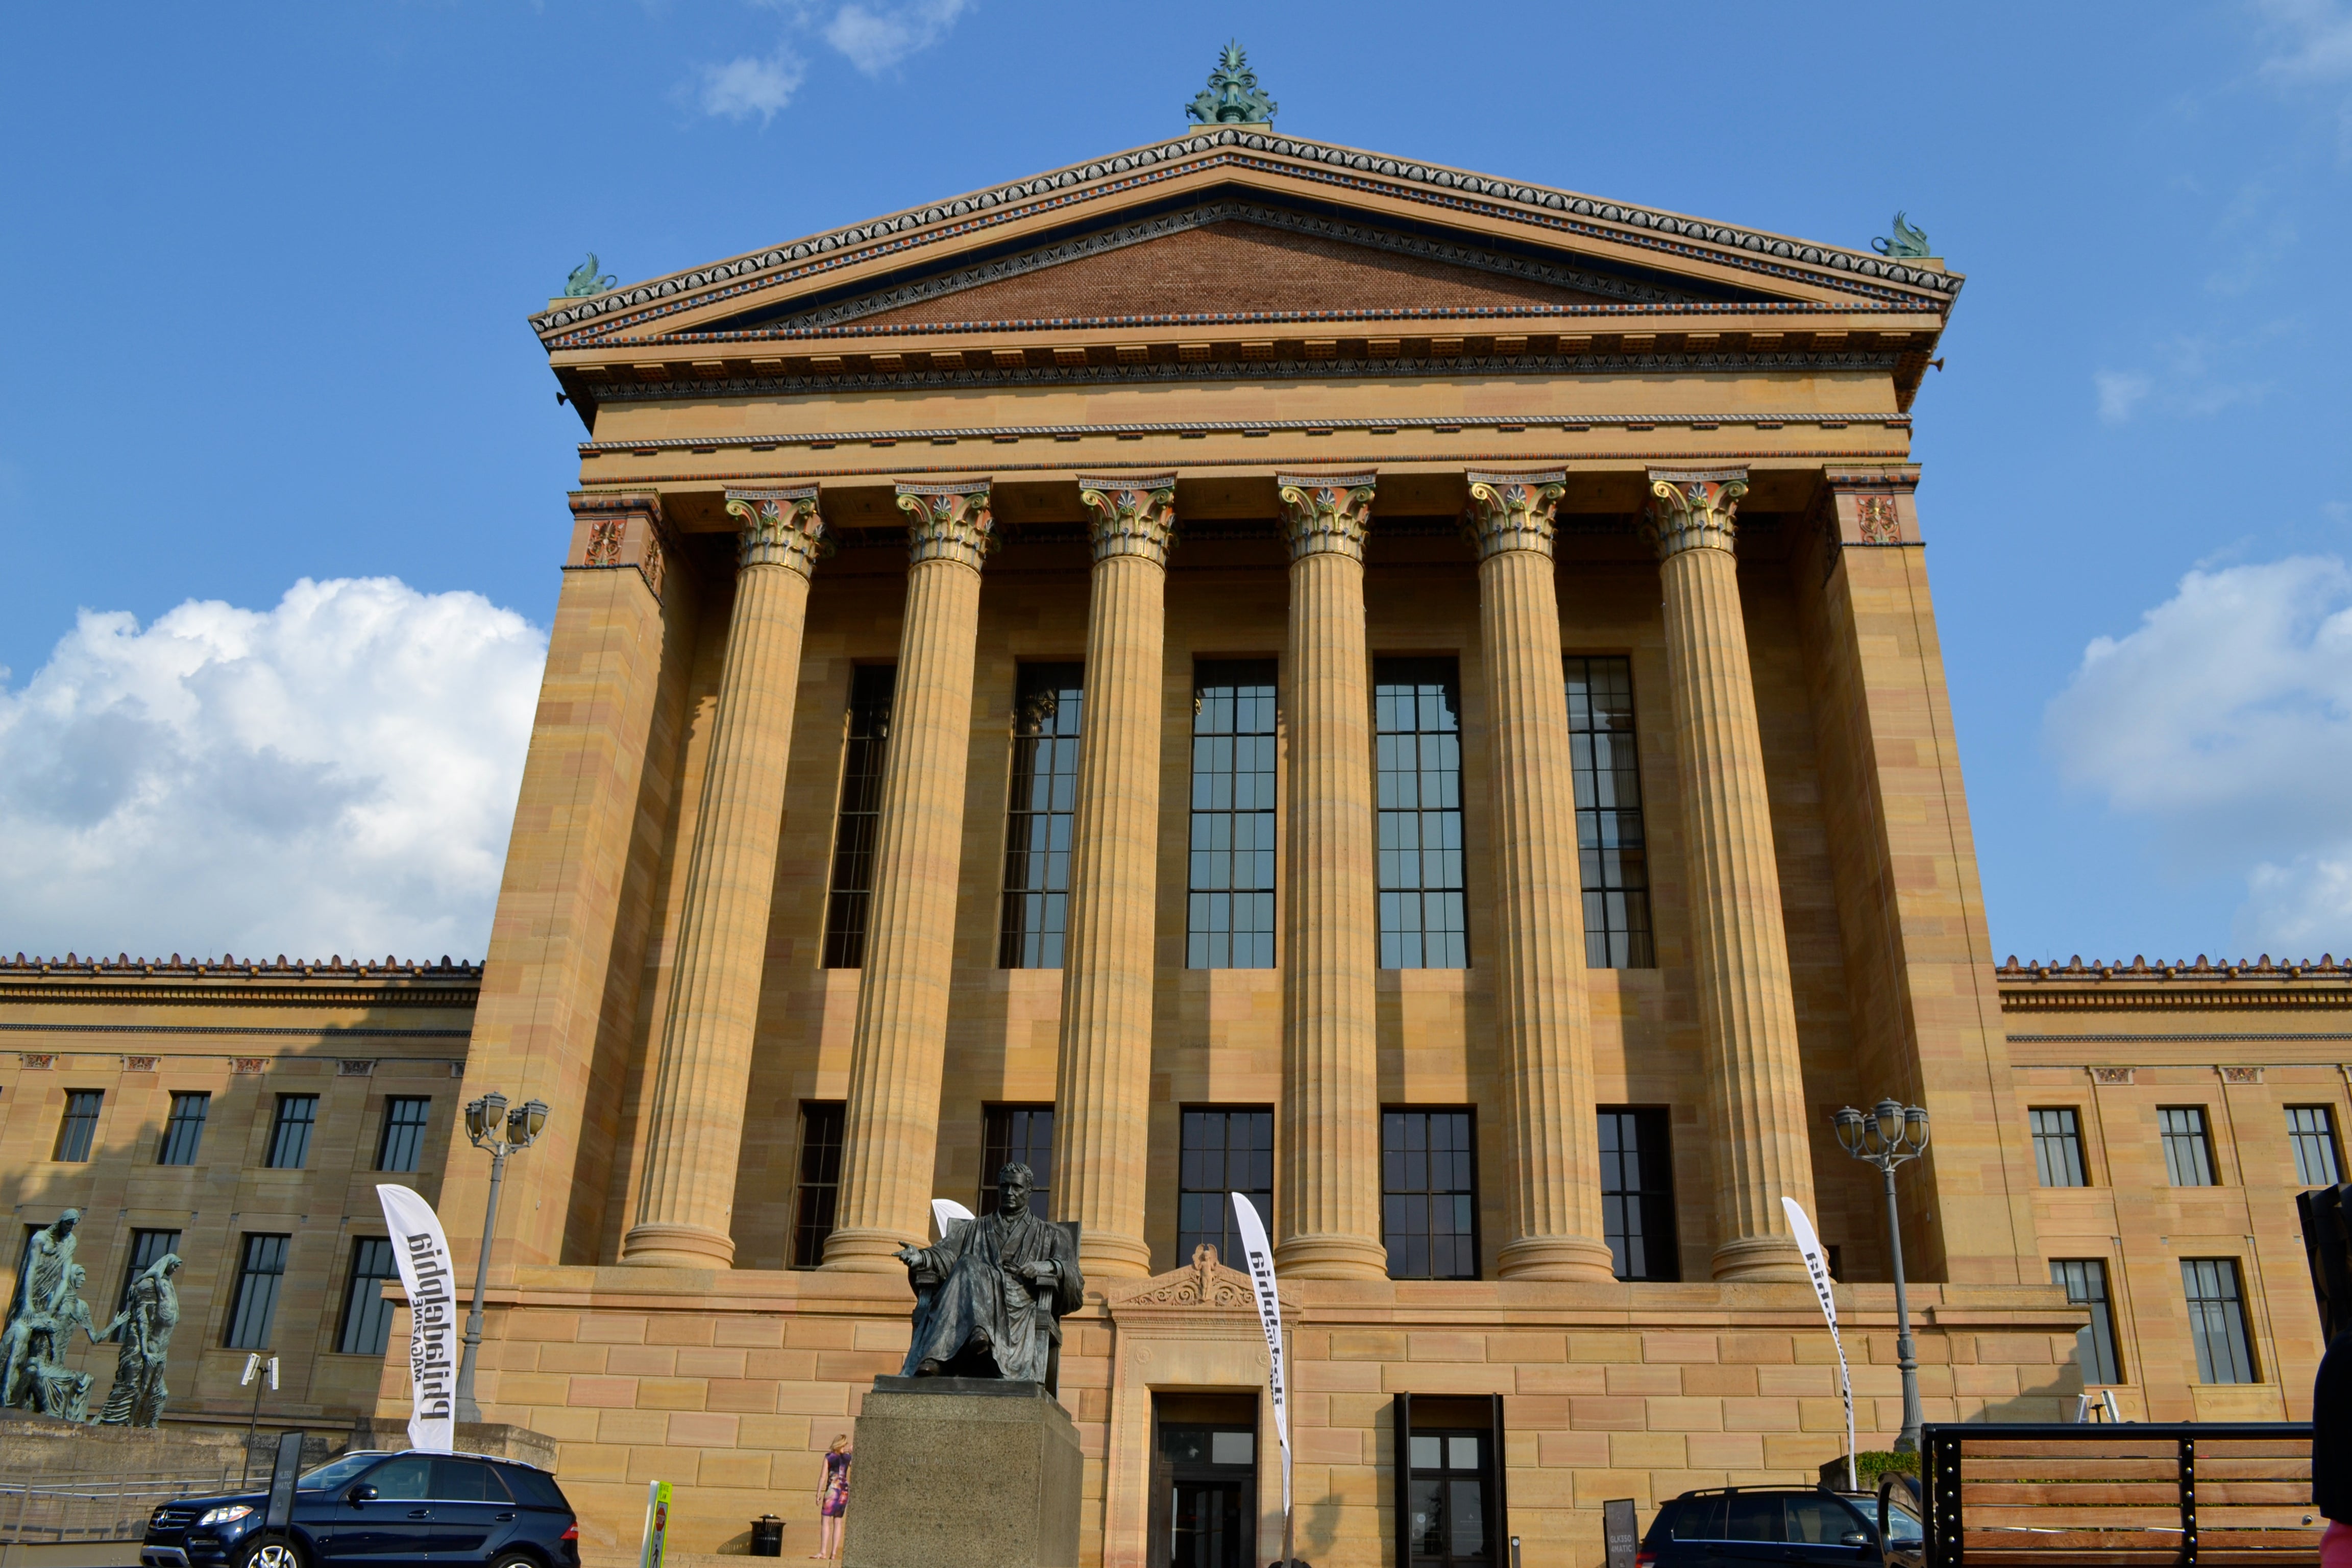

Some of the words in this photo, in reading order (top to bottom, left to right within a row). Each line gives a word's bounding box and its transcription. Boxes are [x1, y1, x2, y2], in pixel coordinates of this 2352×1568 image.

[278, 1471, 292, 1479] ML350
[275, 1482, 292, 1490] 4MATIC
[656, 1514, 665, 1524] STOP
[1610, 1535, 1632, 1543] GLK350
